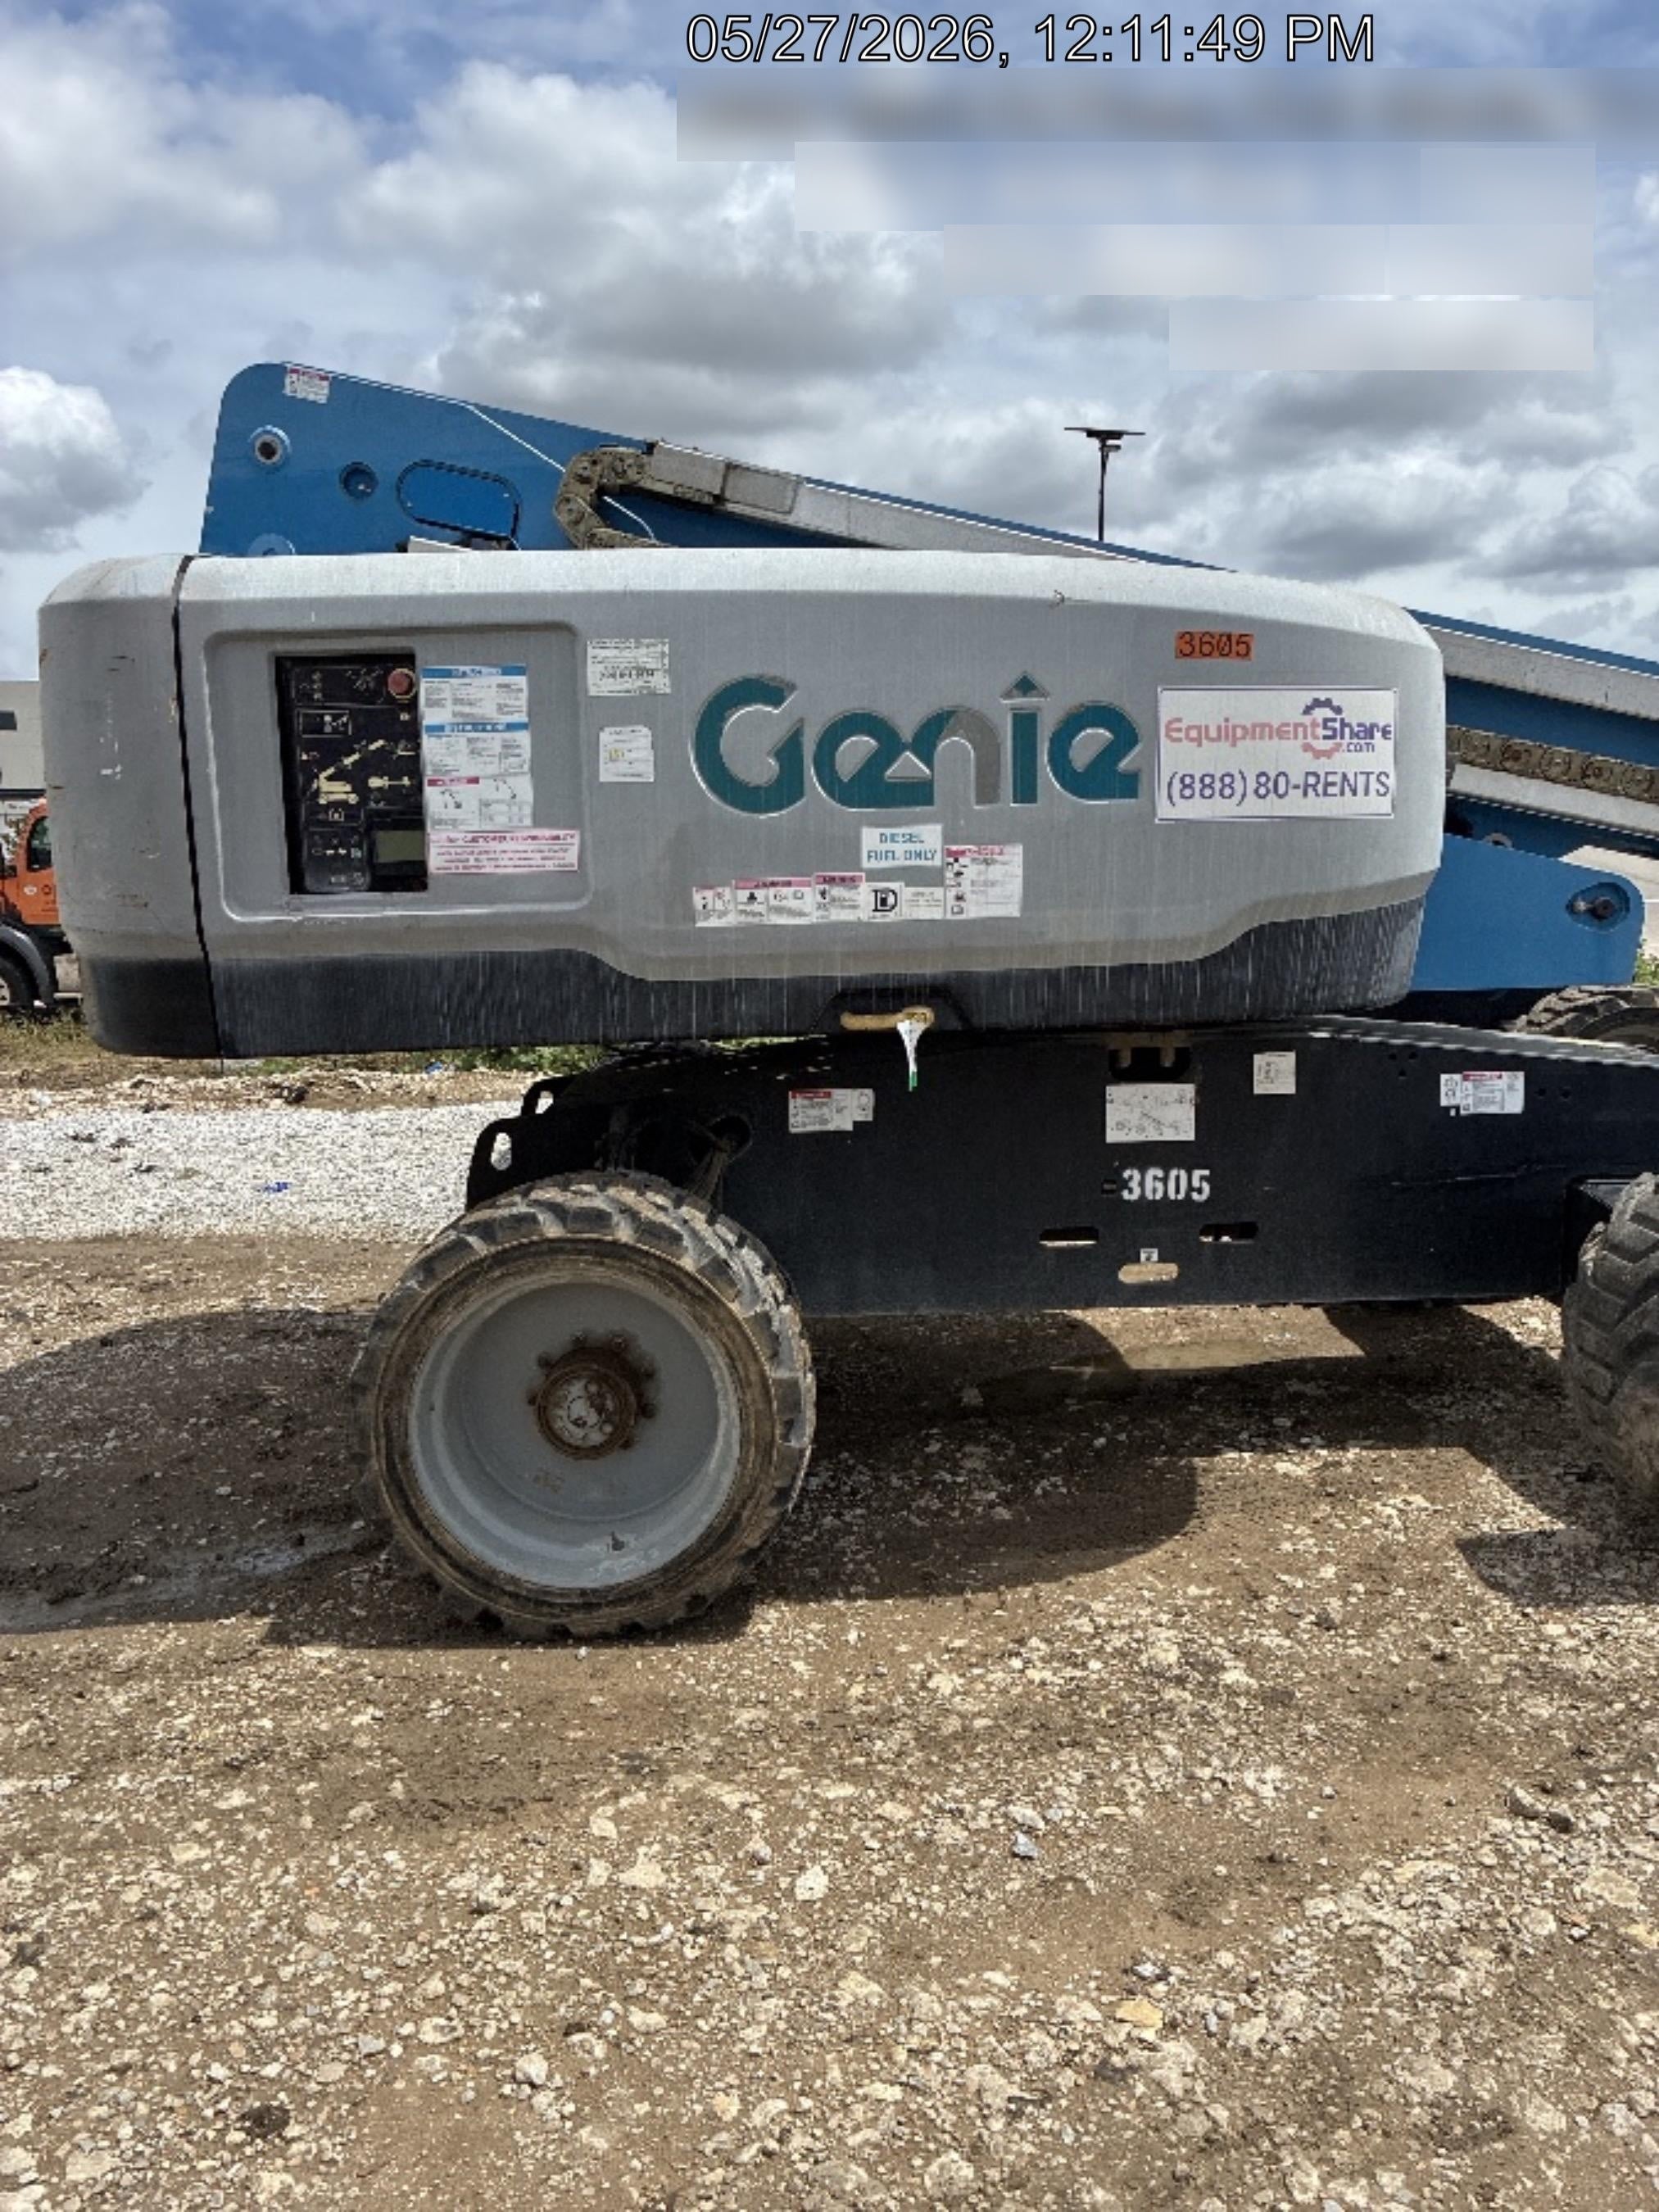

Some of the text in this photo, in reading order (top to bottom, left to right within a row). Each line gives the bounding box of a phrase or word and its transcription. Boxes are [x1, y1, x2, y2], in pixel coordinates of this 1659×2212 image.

[1178, 631, 1252, 658] 3605
[688, 670, 1141, 818] Genie
[1164, 717, 1392, 748] EquipmentShare
[1167, 768, 1391, 807] (888) 80-RENTS
[879, 832, 924, 844] DIESEL
[867, 850, 900, 862] FUEL
[904, 848, 937, 861] ONLY
[1121, 1167, 1212, 1202] 3605
